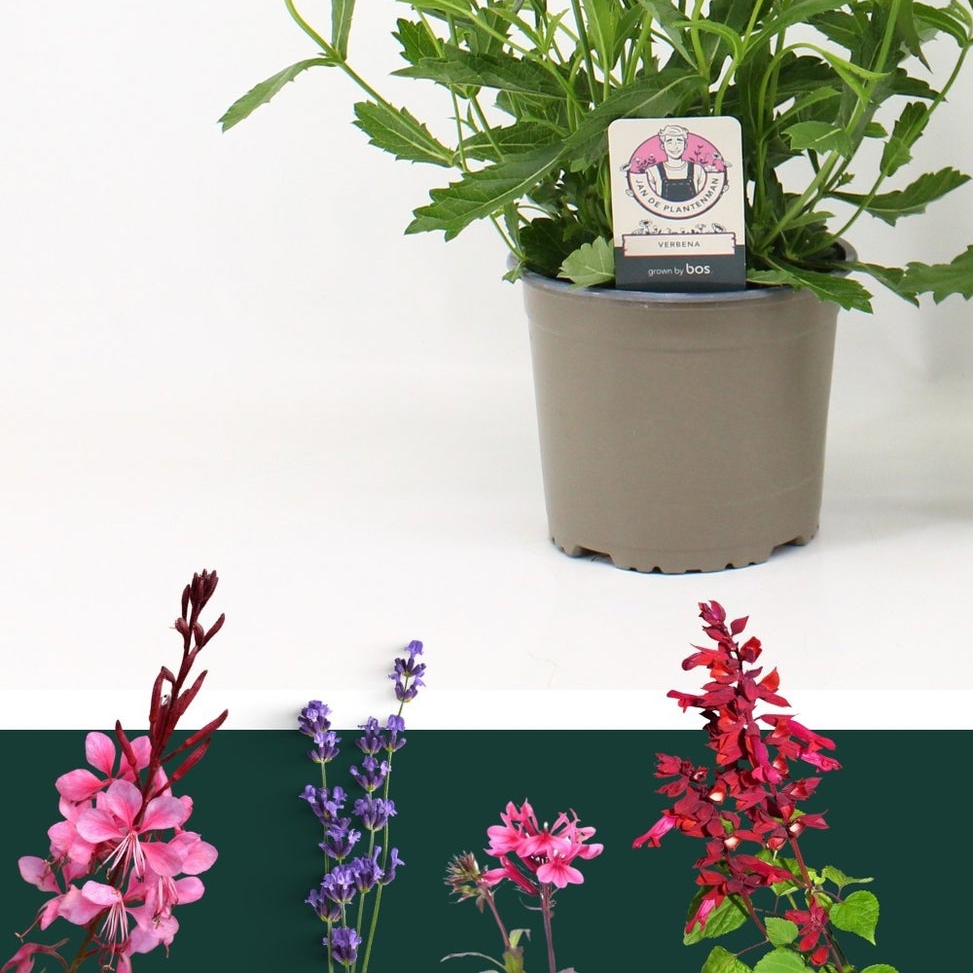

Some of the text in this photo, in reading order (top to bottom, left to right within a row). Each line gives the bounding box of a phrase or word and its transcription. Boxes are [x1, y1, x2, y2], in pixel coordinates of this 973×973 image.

[636, 177, 719, 213] JAN DE PLANTENMAN
[657, 240, 701, 249] VERBENA
[648, 262, 711, 276] grown by bos
